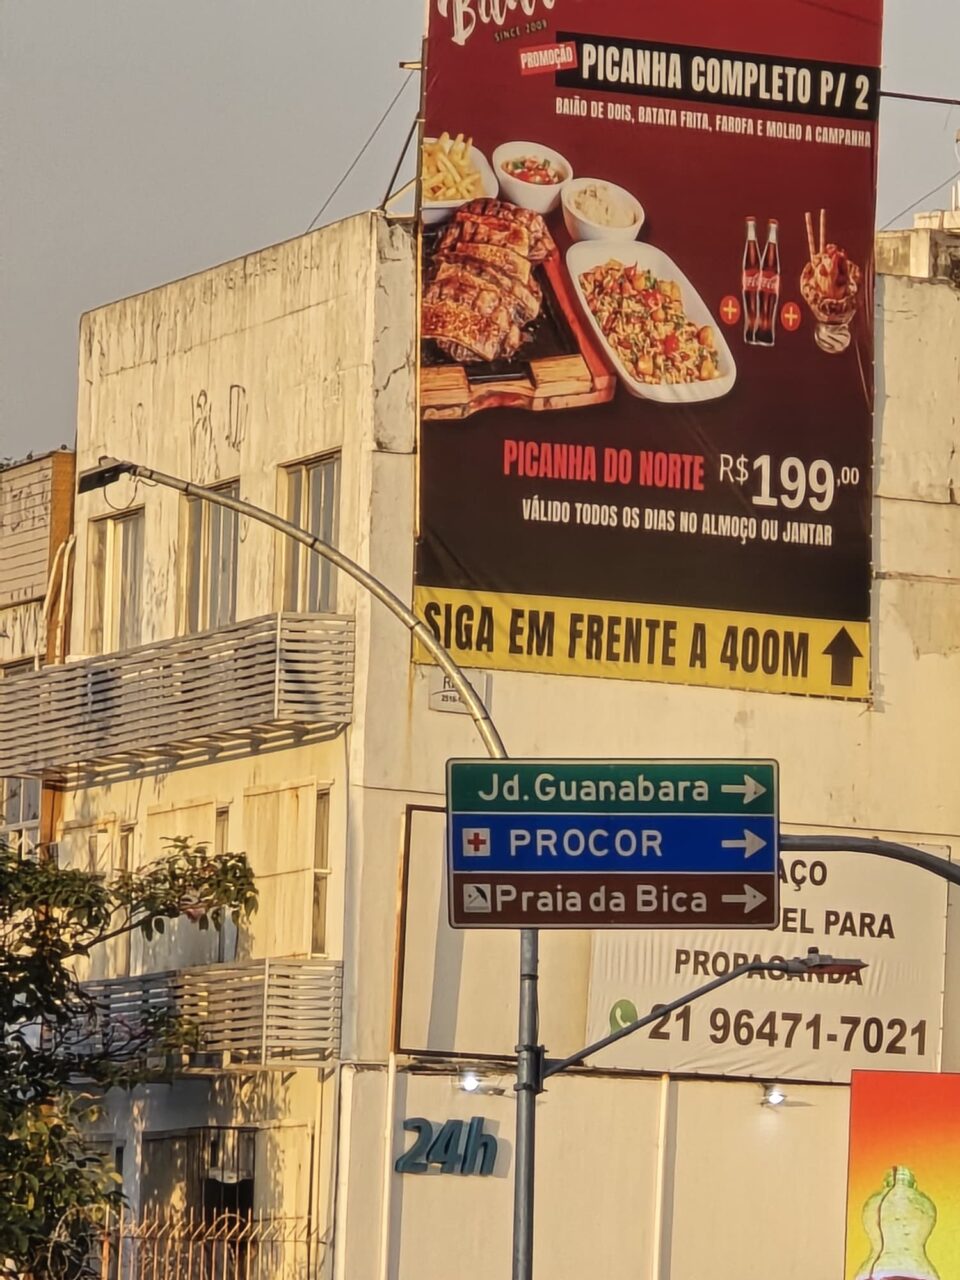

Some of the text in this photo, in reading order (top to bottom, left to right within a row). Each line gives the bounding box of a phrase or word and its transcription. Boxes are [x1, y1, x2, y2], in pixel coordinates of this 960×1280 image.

[494, 26, 521, 42] SINCE
[520, 44, 573, 70] PROMOÇÃO
[582, 43, 870, 110] PICANHA COMPLETO P/ 2
[555, 95, 871, 148] BAIÃO DE DOIS, BATATA FRITA, FAROFA E MOLHO A CAMPANHA
[503, 439, 705, 491] PICANHA DO NORTE
[523, 495, 833, 546] VÁLIDO TODOS OS DIAS NO ALMOÇO OU JANTAR
[424, 601, 809, 679] SIGA EM FRENTE A 400M
[509, 829, 663, 857] PROCOR
[495, 884, 708, 912] Praia da Bica
[825, 910, 895, 939] PARA
[675, 949, 863, 986] PROPAGA
[648, 1004, 928, 1056] 21 96471-7021
[395, 1116, 498, 1176] 24h
